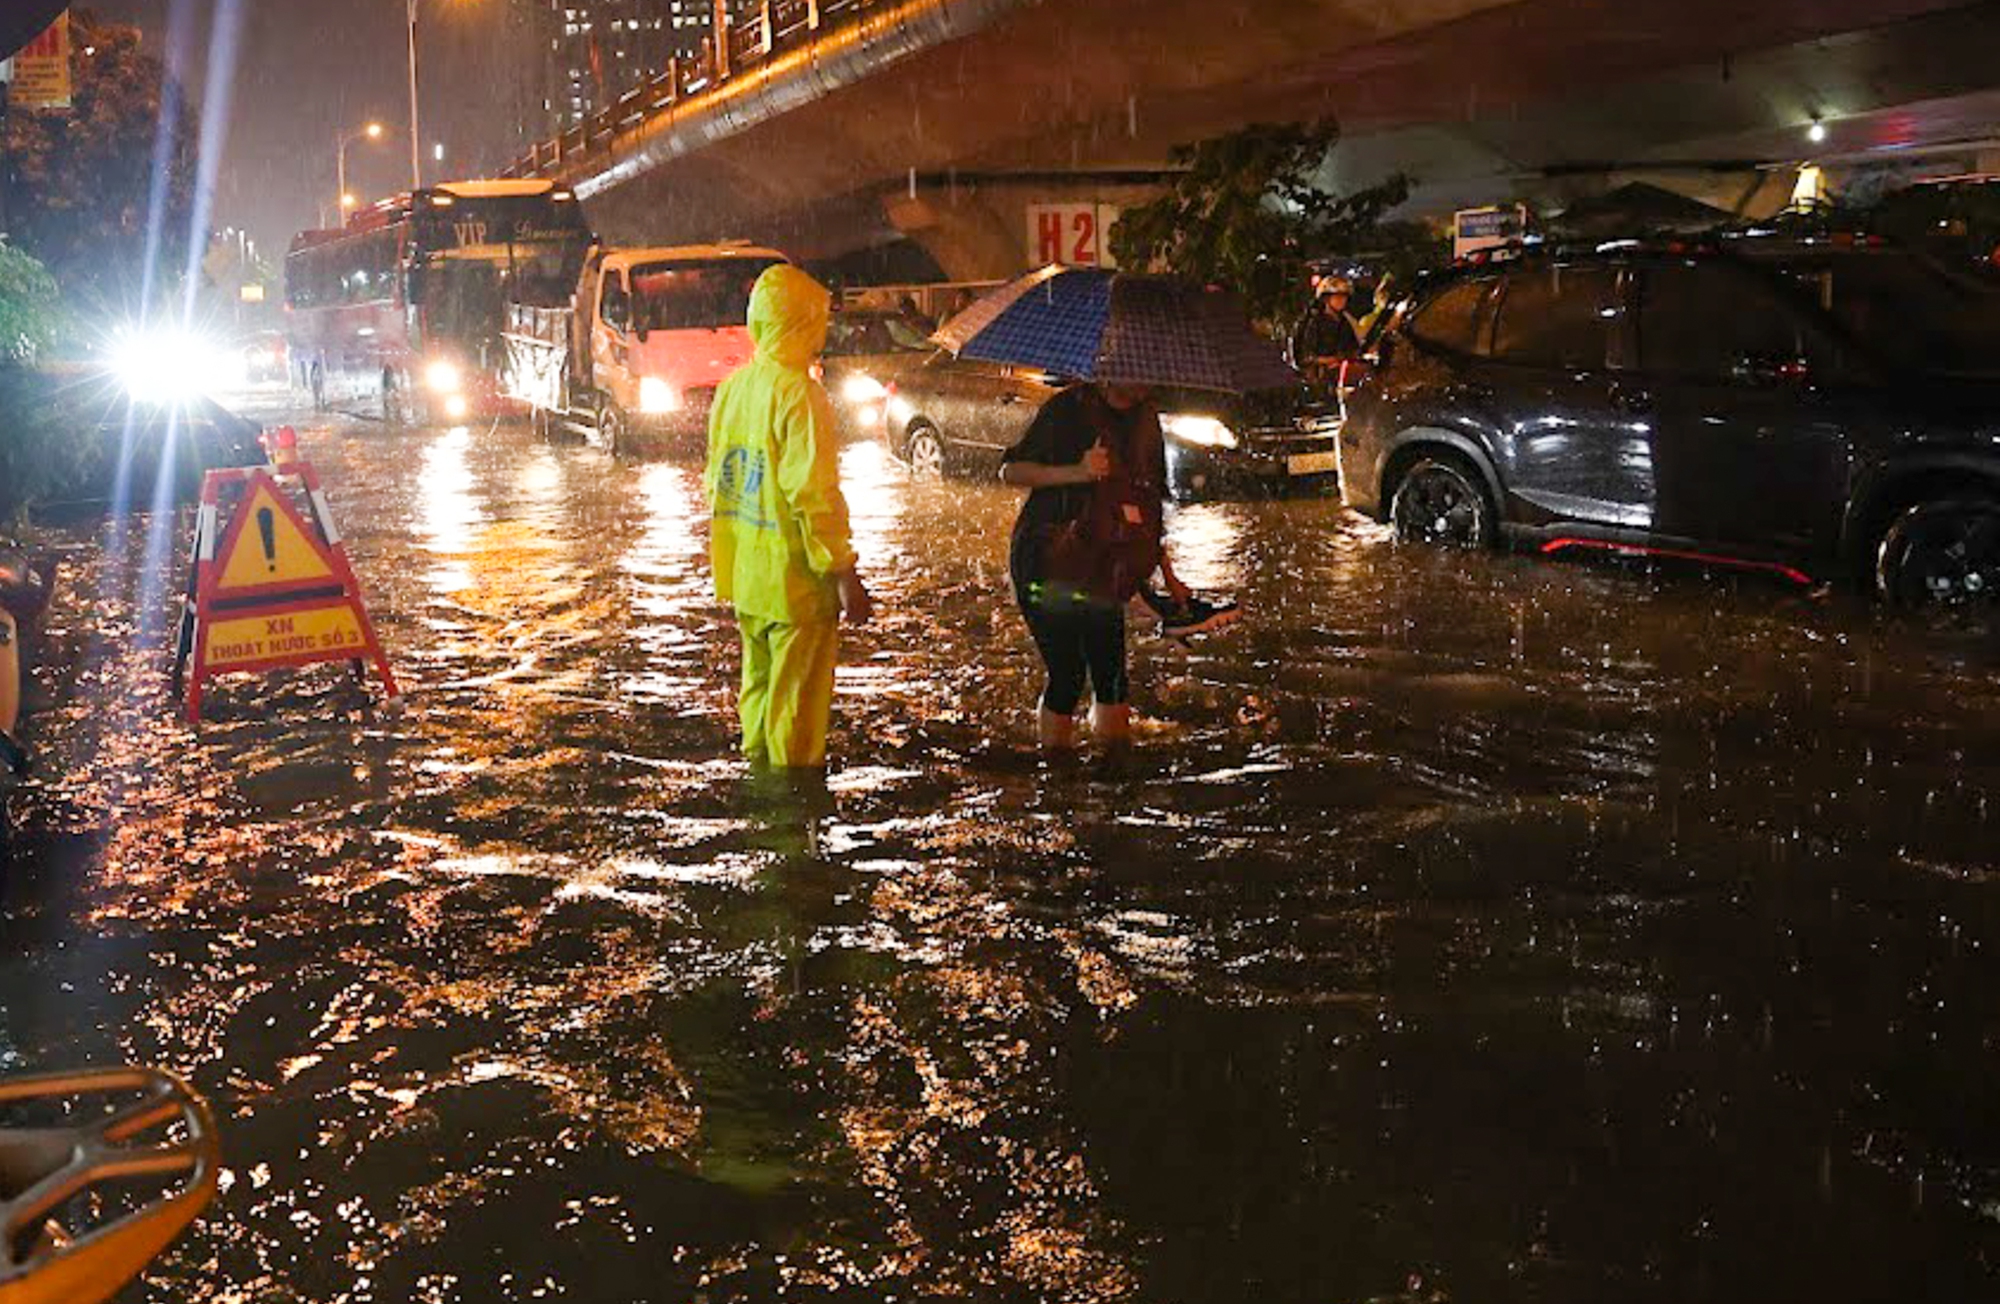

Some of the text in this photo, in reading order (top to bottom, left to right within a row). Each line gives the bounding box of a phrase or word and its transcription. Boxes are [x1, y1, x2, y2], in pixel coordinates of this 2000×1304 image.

[454, 222, 487, 248] VIP
[266, 617, 294, 635] XN
[348, 630, 359, 643] 3
